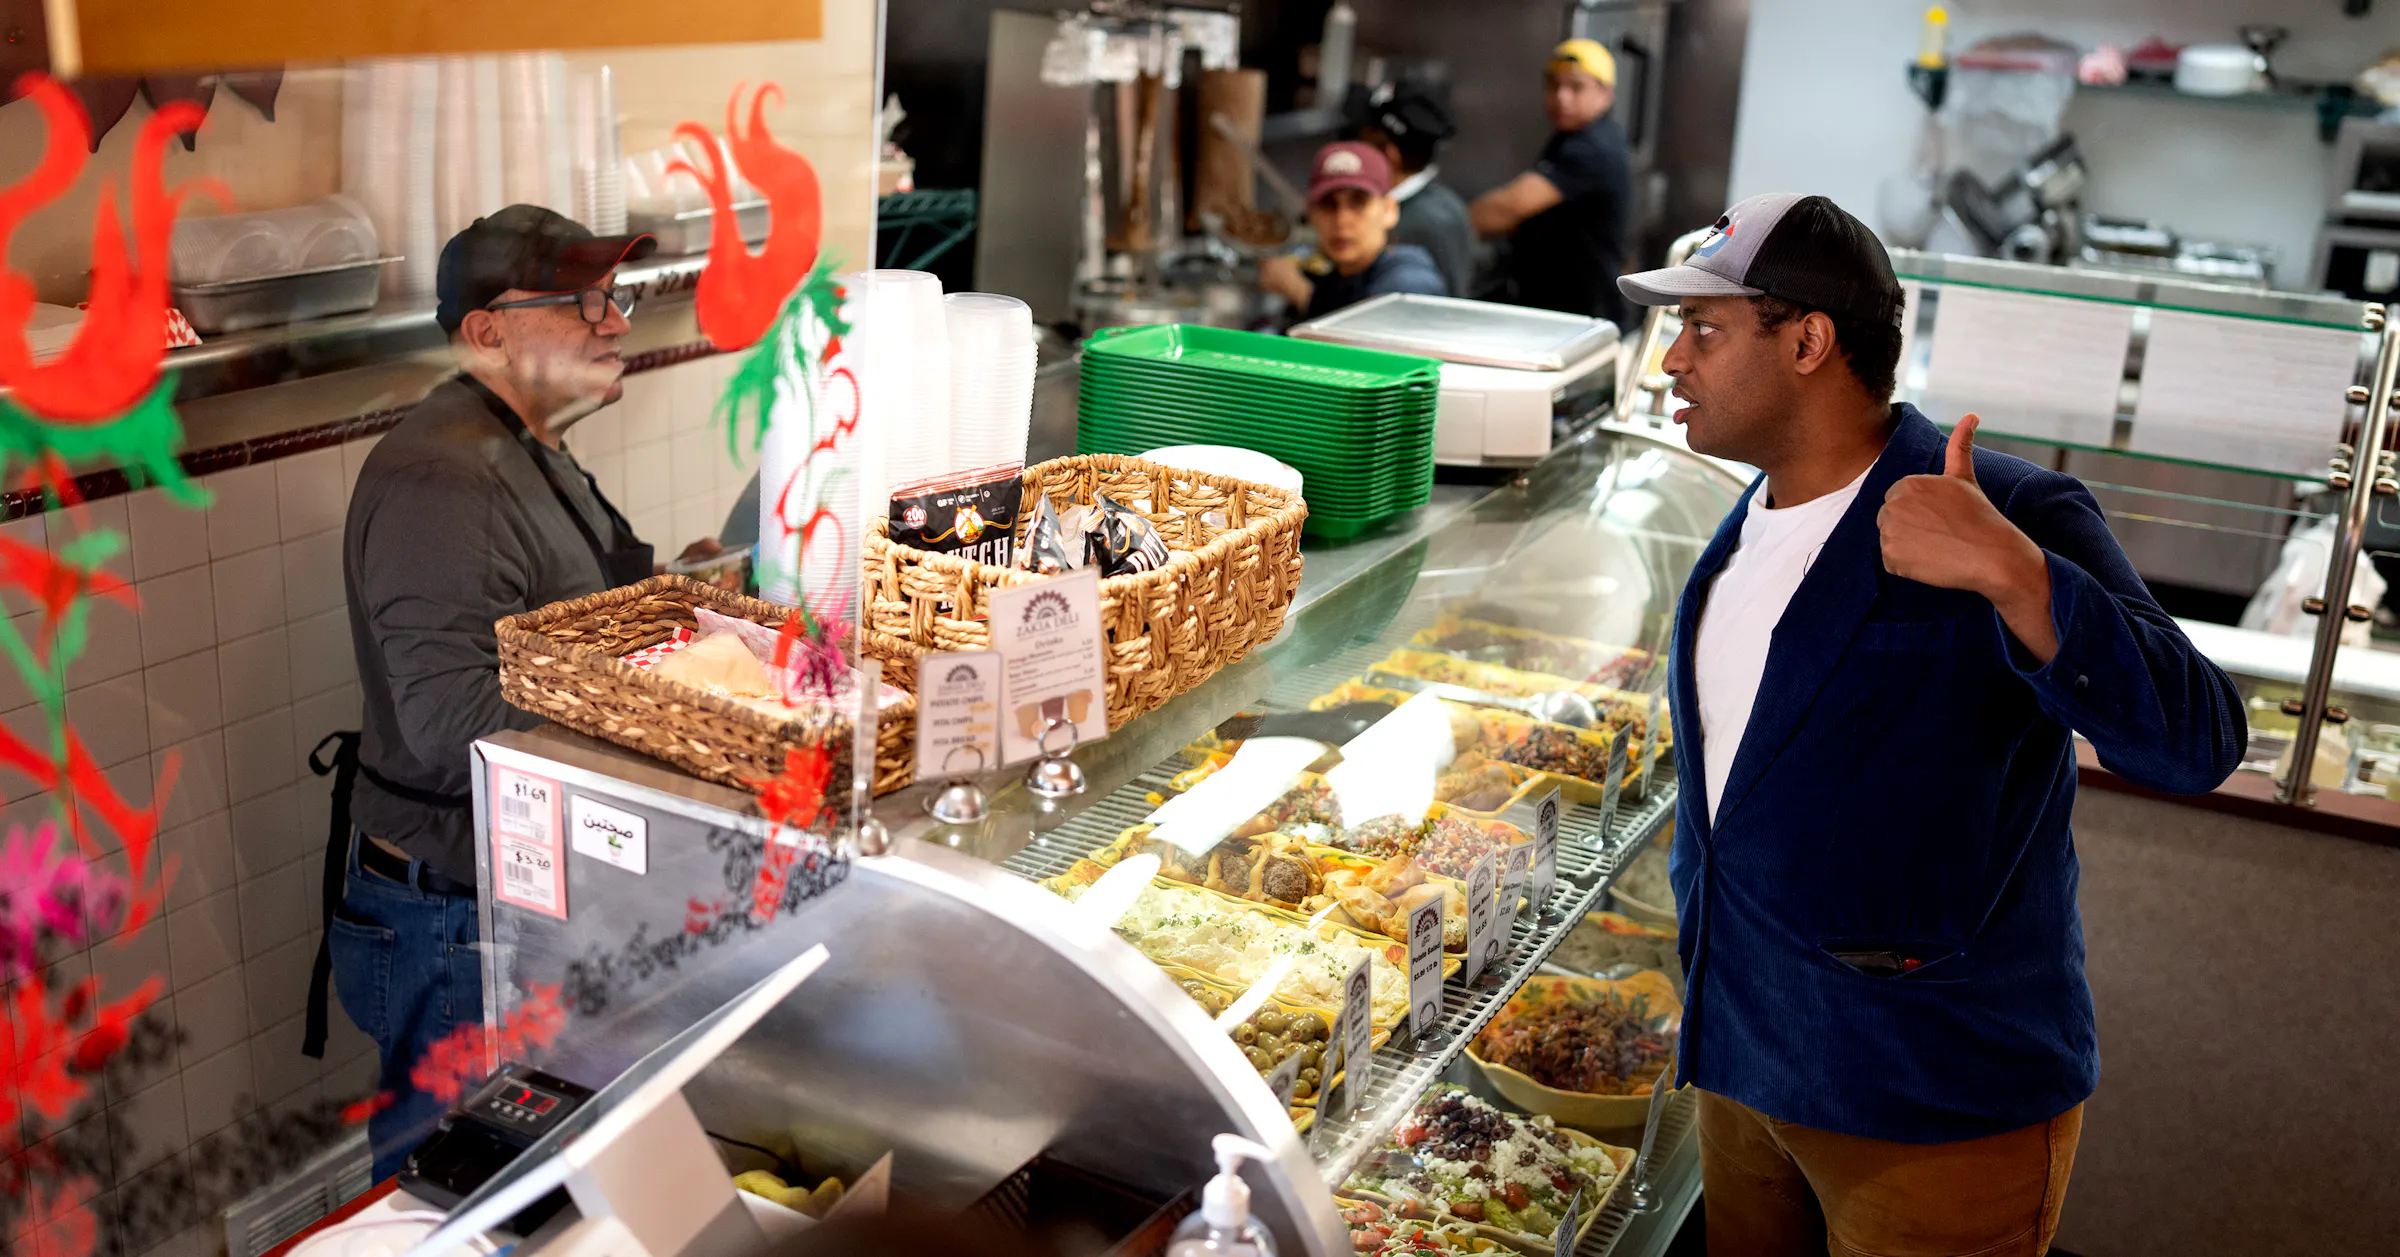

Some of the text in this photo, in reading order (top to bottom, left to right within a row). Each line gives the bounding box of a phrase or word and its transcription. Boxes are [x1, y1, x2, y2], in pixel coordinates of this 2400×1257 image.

[906, 507, 925, 521] 200
[1016, 612, 1080, 638] ZAKIA DELI
[1034, 637, 1064, 650] Drinks
[514, 782, 547, 803] $1.69
[583, 813, 634, 839] صحتين
[515, 851, 551, 869] $3.20
[1412, 941, 1440, 965] Potato Salad
